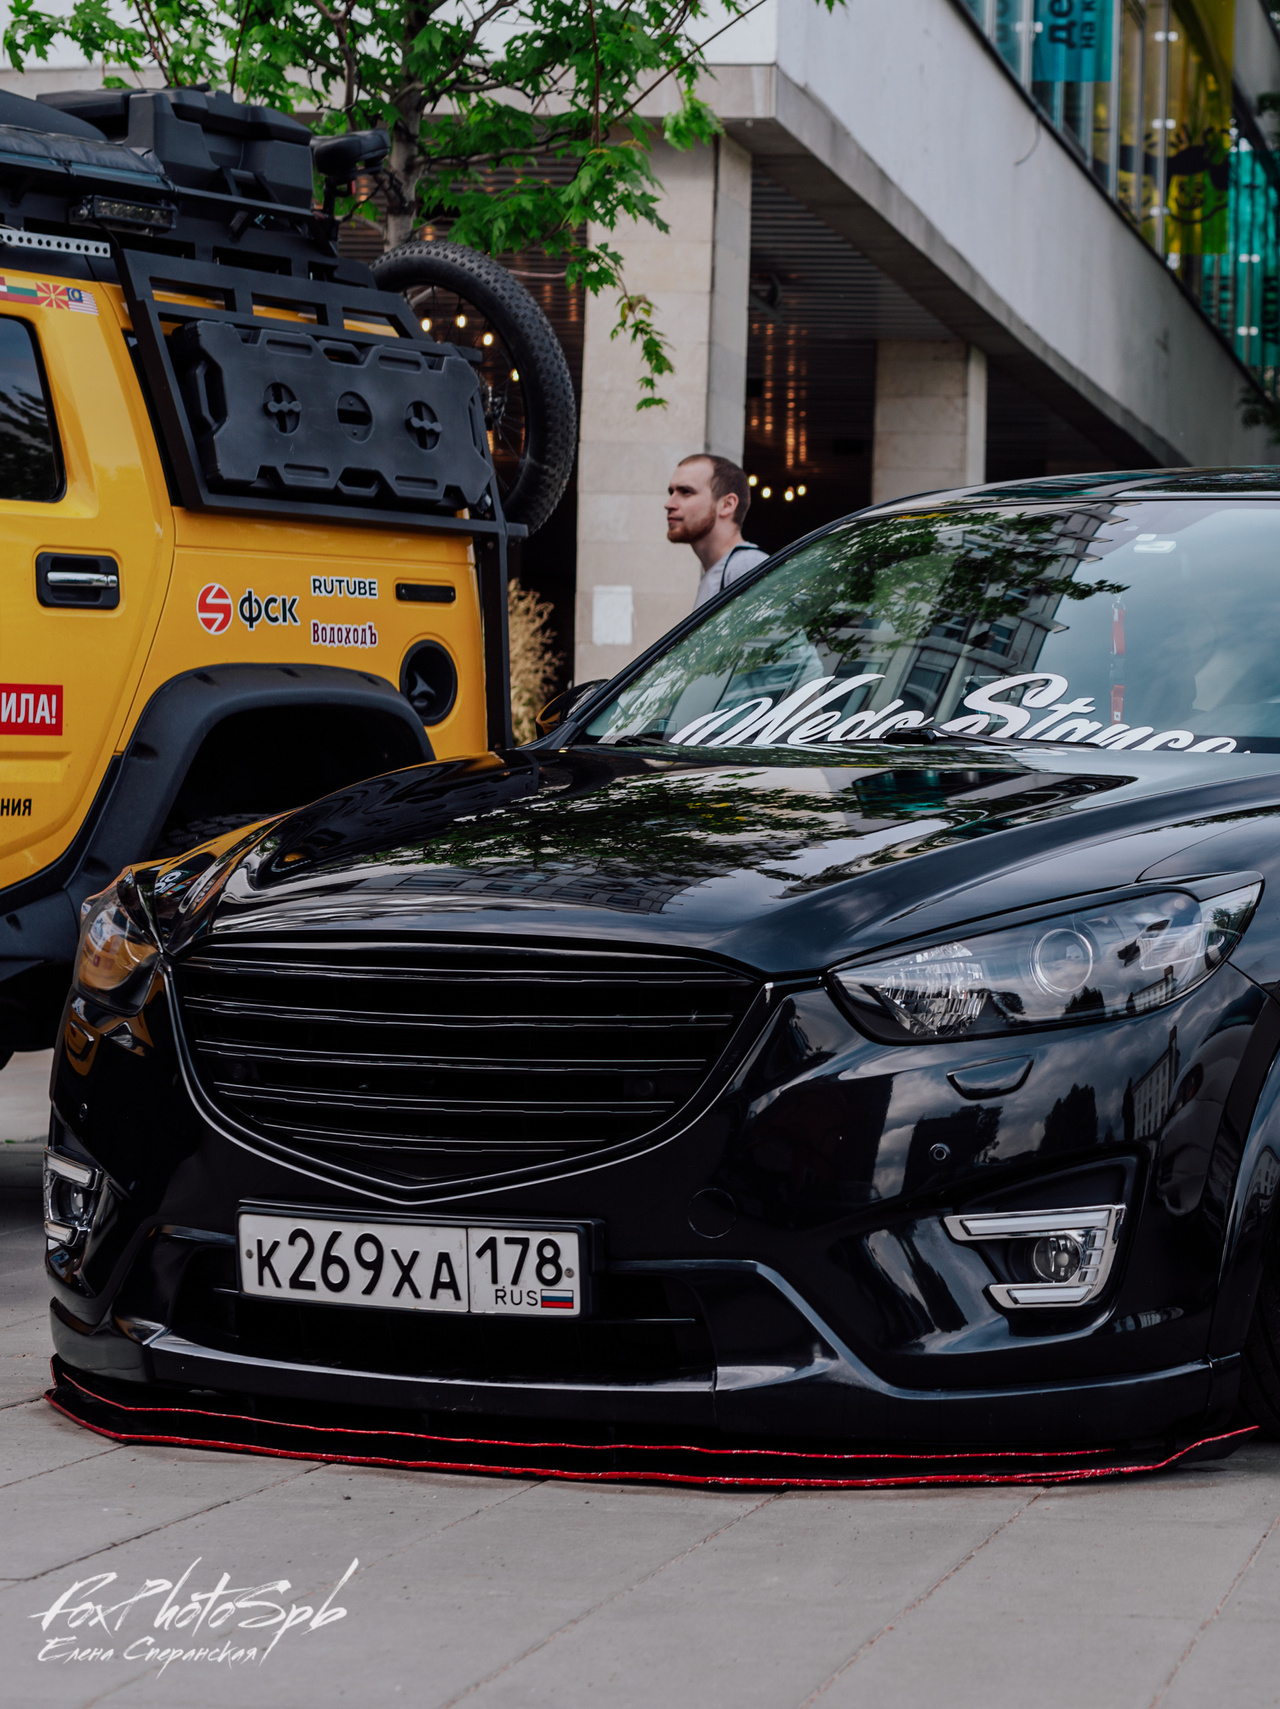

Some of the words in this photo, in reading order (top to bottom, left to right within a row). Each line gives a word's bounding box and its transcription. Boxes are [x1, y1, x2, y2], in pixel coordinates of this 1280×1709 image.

[312, 578, 377, 597] RUTUBE
[240, 590, 299, 629] ФСК
[257, 1227, 461, 1301] К269ХА
[475, 1236, 562, 1287] 178
[494, 1288, 538, 1307] RUS
